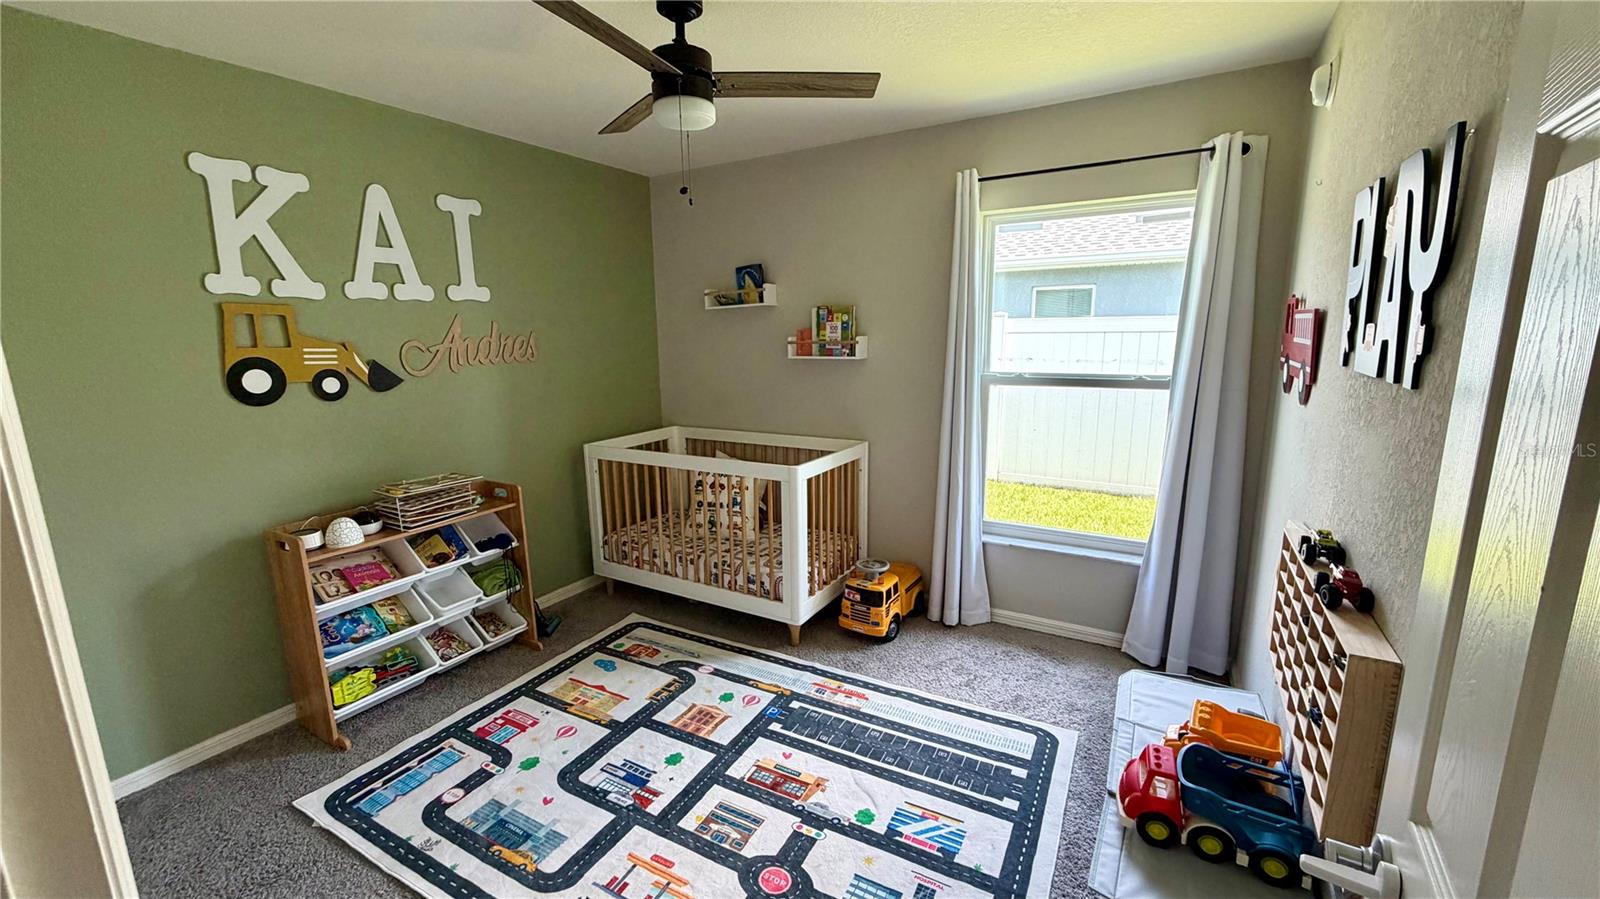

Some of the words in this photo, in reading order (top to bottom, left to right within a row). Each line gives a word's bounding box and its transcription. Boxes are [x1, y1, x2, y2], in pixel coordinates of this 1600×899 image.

[187, 151, 491, 302] KAI
[1341, 120, 1467, 390] PLAY
[400, 312, 539, 377] Andres
[767, 706, 778, 716] P
[505, 823, 525, 835] CINEMA
[762, 872, 787, 887] STOP
[913, 874, 945, 891] HOSPITAL
